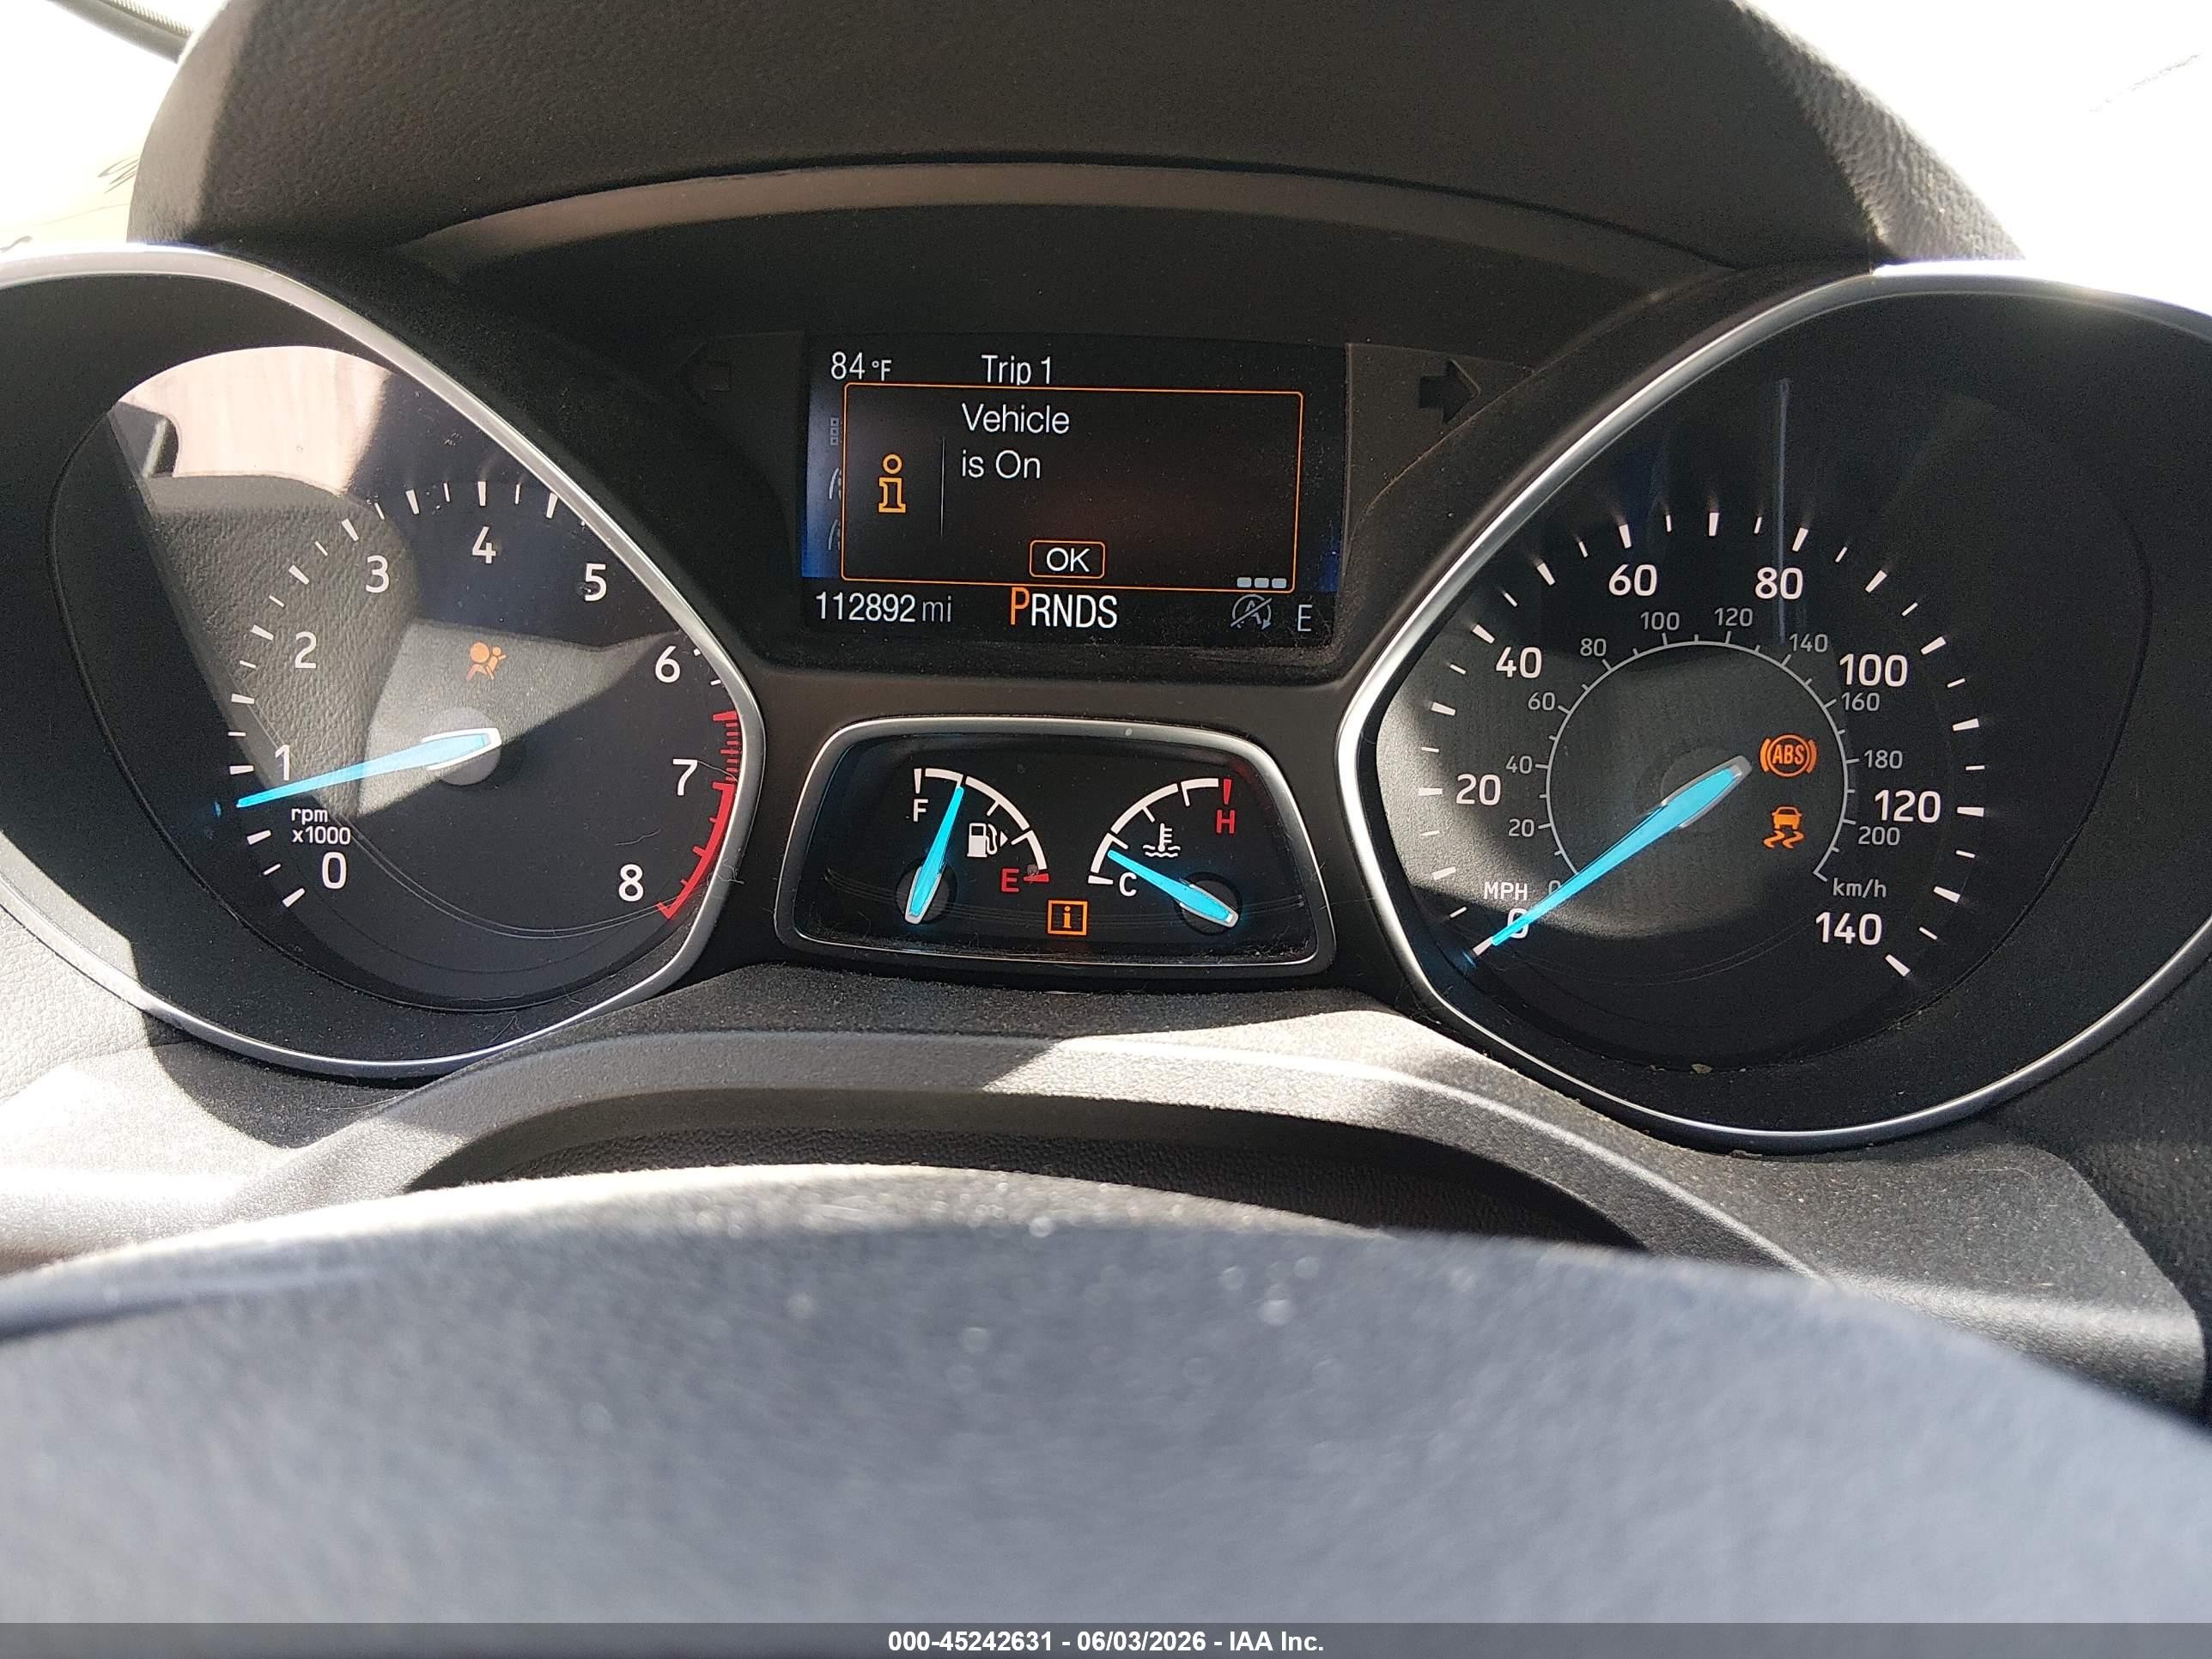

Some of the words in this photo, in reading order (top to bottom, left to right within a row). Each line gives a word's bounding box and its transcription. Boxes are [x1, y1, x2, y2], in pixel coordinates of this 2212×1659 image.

[830, 352, 866, 380] 84
[981, 354, 1032, 386] Trip
[1040, 357, 1053, 384] 1
[961, 402, 1071, 434] Vehicle
[961, 448, 985, 478] is
[995, 450, 1042, 480] On
[471, 527, 496, 564] 4
[1045, 547, 1091, 573] OK
[365, 556, 390, 593] 3
[584, 563, 608, 601] 5
[1608, 563, 1657, 597] 60
[1754, 567, 1803, 600] 80
[815, 592, 915, 623] 112892
[921, 596, 953, 623] mi
[1009, 586, 1118, 629] PRNDS
[1297, 605, 1312, 632] E
[1640, 611, 1680, 632] 100
[1713, 607, 1753, 629] 120
[294, 632, 318, 669] 2
[1580, 637, 1607, 658] 80
[1790, 633, 1828, 655] 140
[655, 646, 681, 684] 6
[1496, 647, 1543, 678] 40
[1840, 654, 1908, 686] 100
[1528, 693, 1556, 712] 60
[1841, 692, 1881, 712] 160
[275, 744, 292, 781] 1
[1505, 755, 1533, 775] 40
[1772, 744, 1806, 767] ABS
[1863, 750, 1904, 770] 180
[672, 759, 698, 796] 7
[1456, 775, 1501, 807] 20
[291, 807, 328, 823] rpm
[913, 799, 929, 822] F
[1874, 790, 1941, 823] 120
[292, 826, 351, 845] x1000
[1216, 811, 1235, 834] H
[1508, 817, 1534, 838] 20
[1858, 826, 1900, 847] 200
[322, 852, 347, 889] 0
[618, 864, 644, 902] 8
[1001, 867, 1019, 892] E
[1119, 872, 1138, 897] C
[1483, 883, 1528, 901] MPH
[1832, 878, 1887, 899] km/h
[1815, 913, 1882, 944] 140
